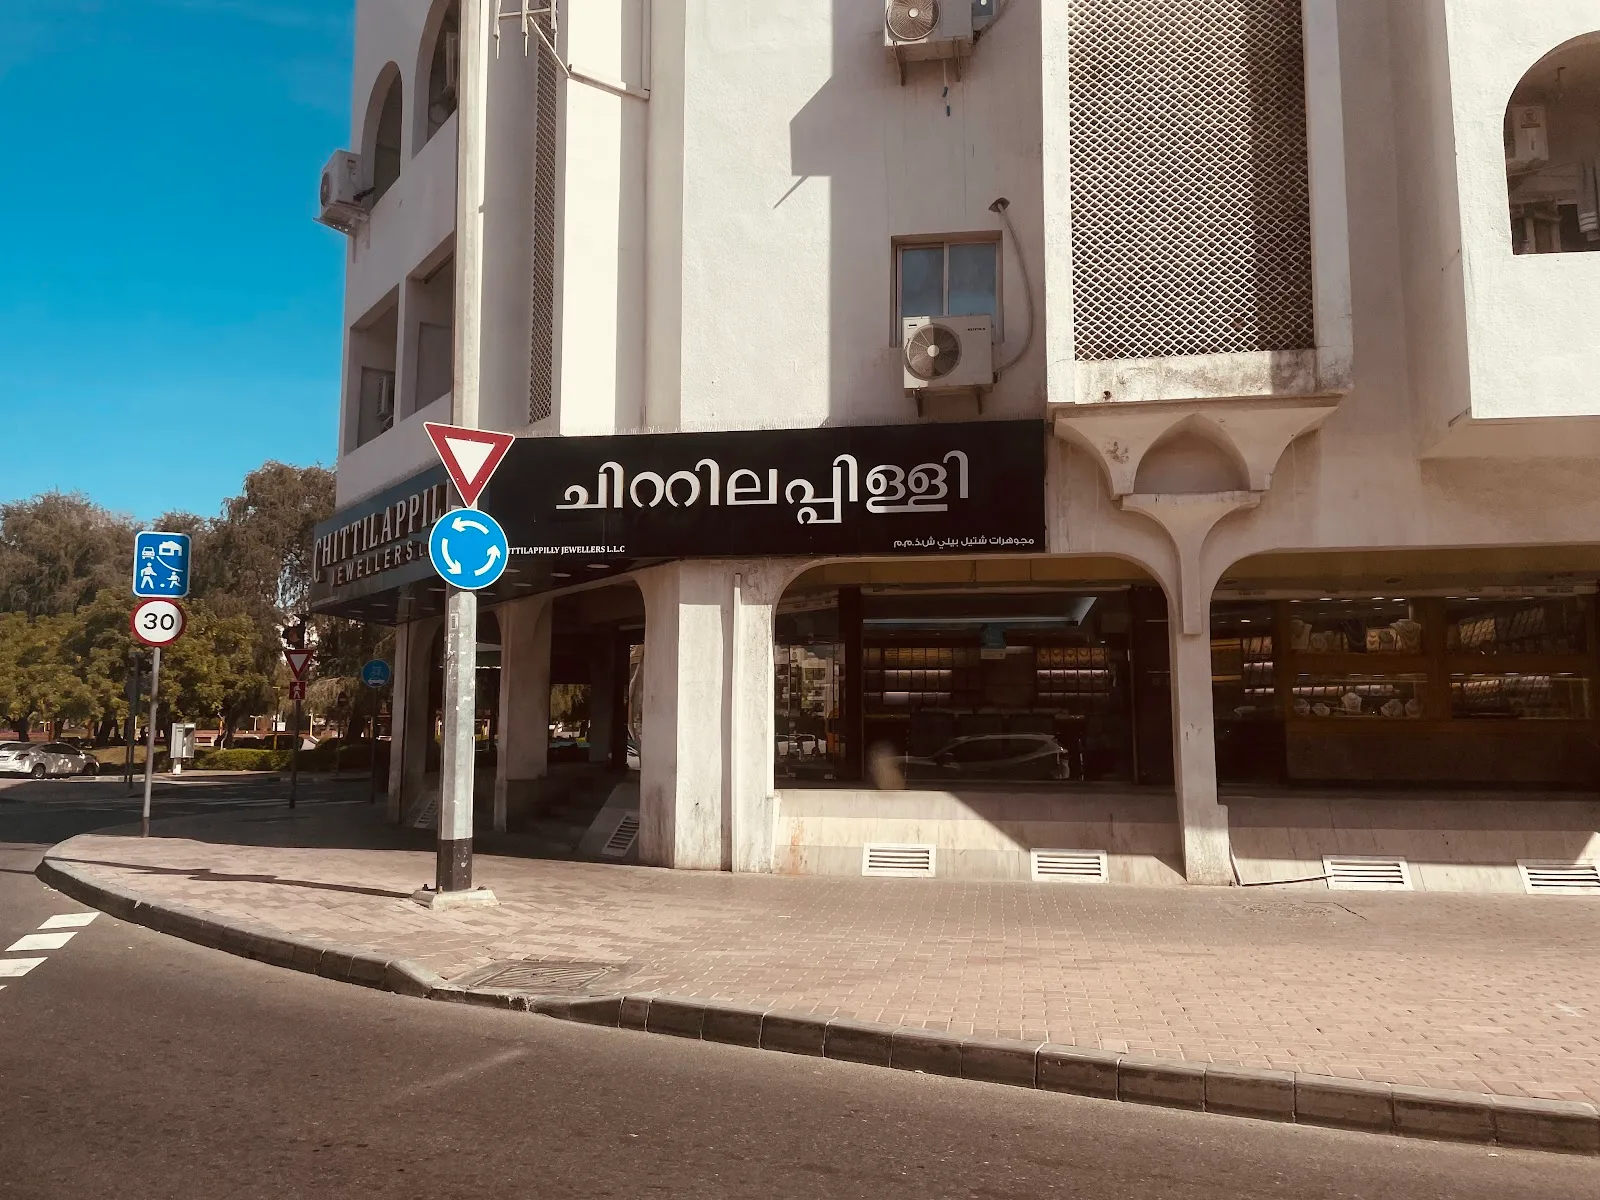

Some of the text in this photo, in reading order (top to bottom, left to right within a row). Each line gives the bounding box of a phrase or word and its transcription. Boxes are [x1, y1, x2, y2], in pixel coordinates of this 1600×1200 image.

[936, 537, 959, 549] بيلي
[960, 534, 987, 547] شتيل
[989, 536, 1035, 547] مجوهرات
[561, 545, 606, 555] JEWELLERS
[606, 545, 626, 553] L.L.C
[330, 540, 413, 587] JEWELLERS
[143, 612, 175, 631] 30
